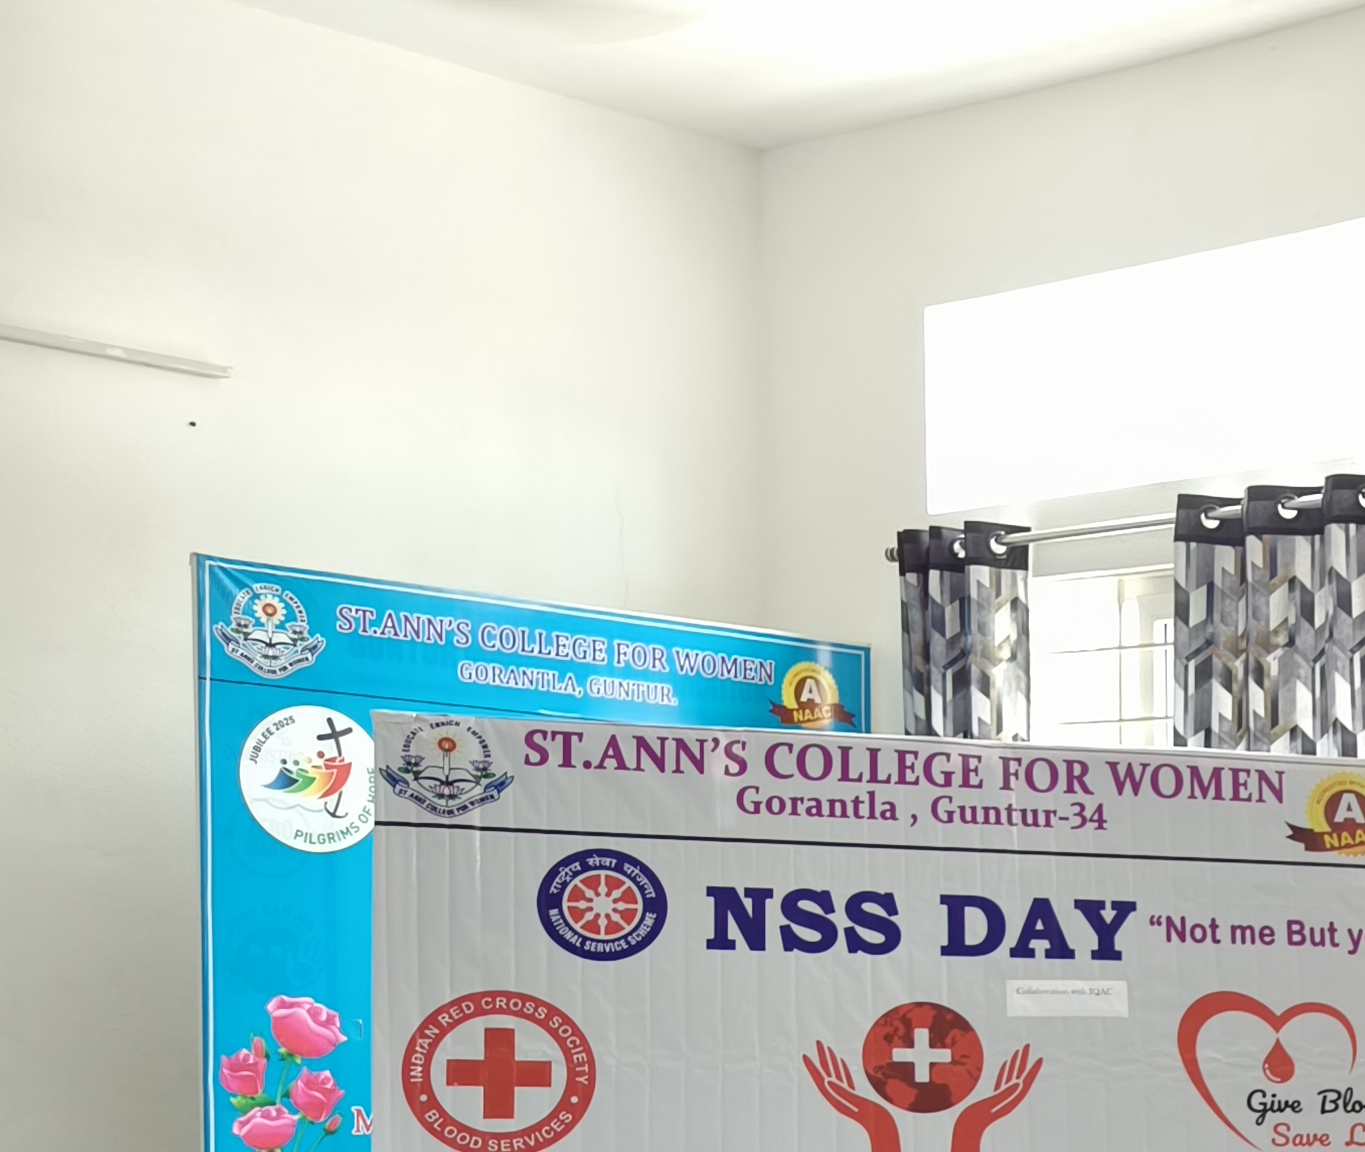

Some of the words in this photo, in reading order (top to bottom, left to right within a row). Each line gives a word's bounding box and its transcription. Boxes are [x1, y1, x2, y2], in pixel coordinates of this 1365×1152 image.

[479, 624, 607, 664] COLLEGE
[615, 640, 669, 672] FOR
[675, 649, 775, 685] WOMEN
[459, 661, 582, 698] GORANTLA,
[587, 677, 678, 706] GUNTUR.
[800, 678, 822, 704] A
[793, 705, 832, 723] NAAC
[249, 727, 275, 764] JUBILEE
[273, 715, 296, 732] 2025
[764, 741, 985, 790] COLLEGE
[998, 755, 1095, 796] FOR
[1105, 760, 1286, 805] WOMEN
[293, 821, 360, 845] PILGRIMS
[358, 805, 373, 825] OF
[736, 785, 899, 821] Gorantla
[930, 795, 1108, 830] Guntur-34
[1333, 793, 1365, 824] A
[548, 908, 582, 947] NATIONAL
[584, 939, 629, 953] SERVICE
[626, 911, 657, 945] SCHEME
[705, 886, 902, 956] NSS
[939, 893, 1137, 961] DAY
[1230, 920, 1276, 946] me
[1287, 920, 1340, 949] But
[410, 1024, 440, 1083] INDIAN
[437, 1001, 475, 1027] RED
[481, 997, 548, 1019] CROSS
[548, 1015, 589, 1085] SOCIETY
[1246, 1089, 1303, 1126] Give
[424, 1109, 483, 1149] BLOOD
[487, 1110, 573, 1152] SERVICES
[1270, 1122, 1331, 1148] Save
